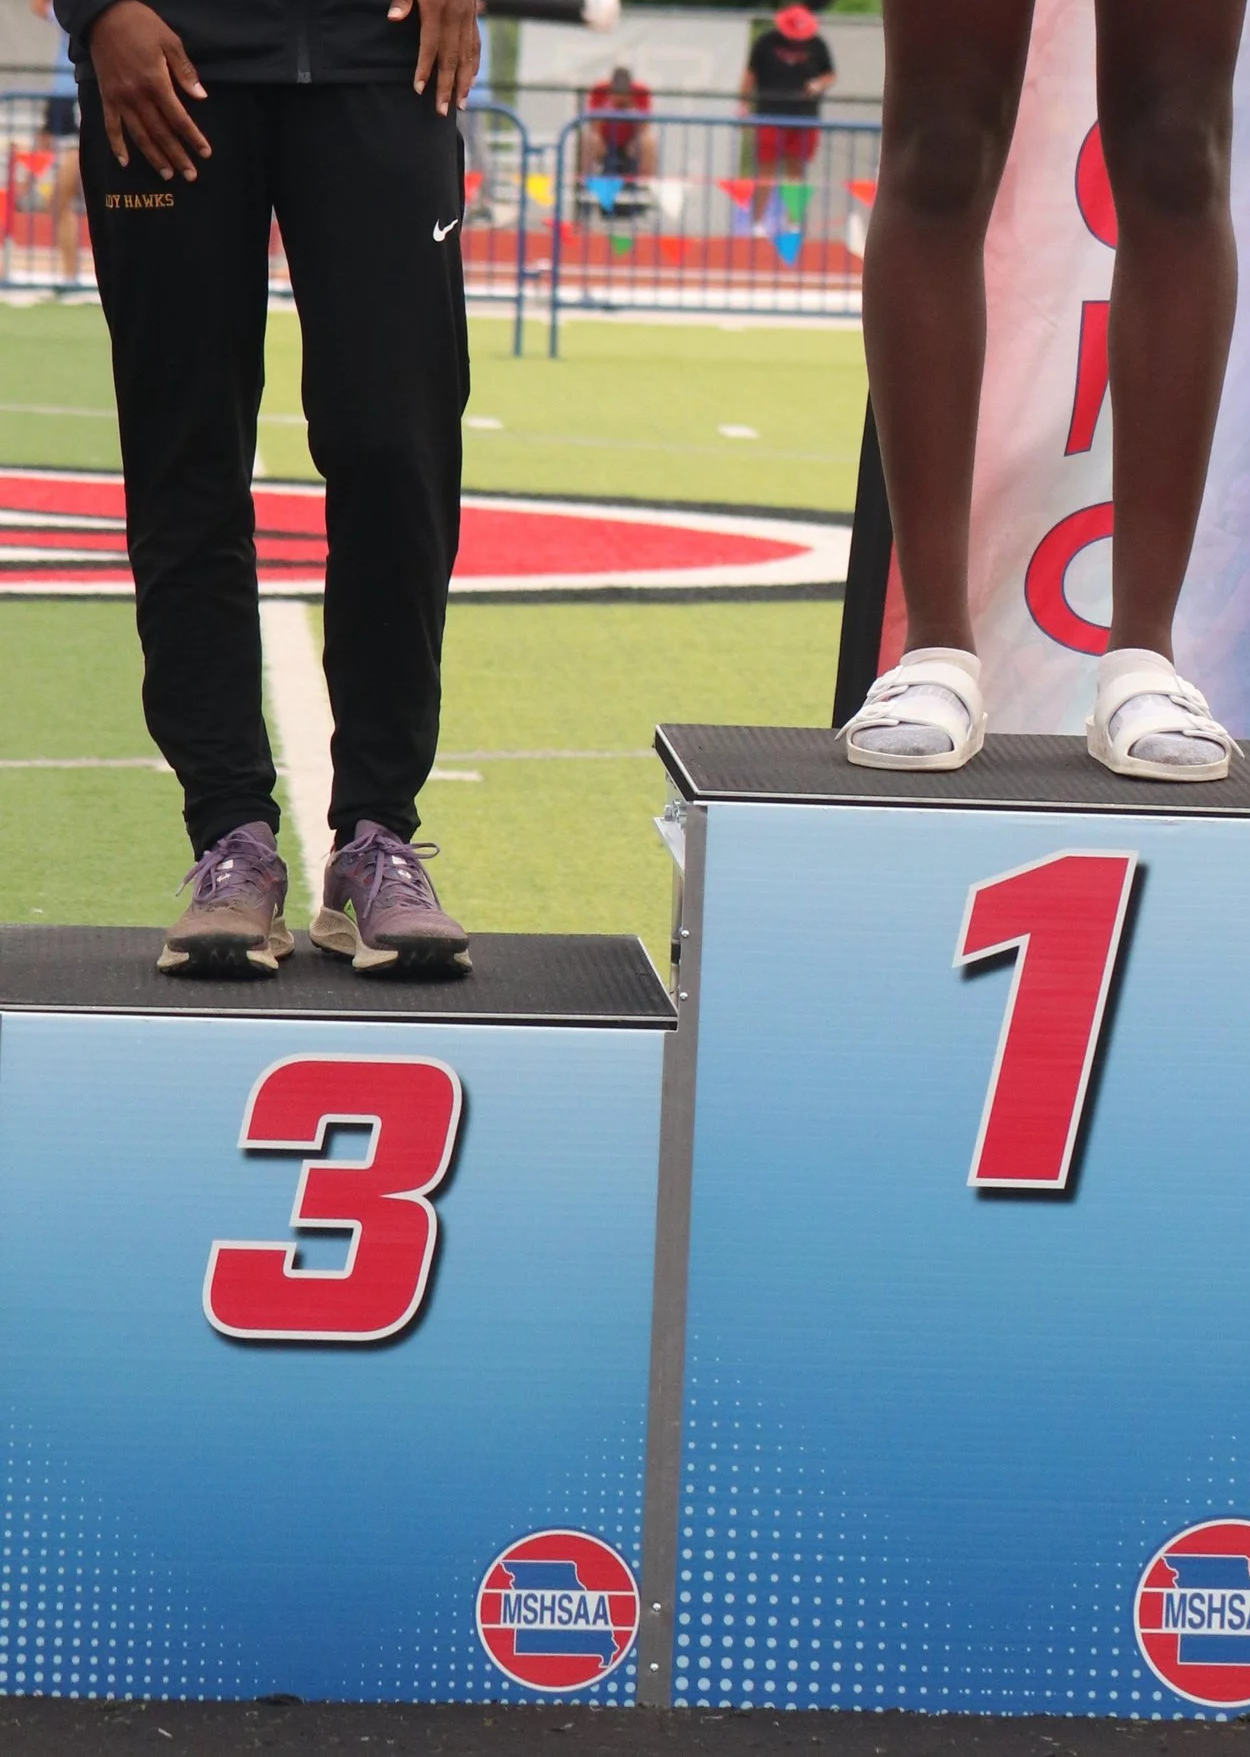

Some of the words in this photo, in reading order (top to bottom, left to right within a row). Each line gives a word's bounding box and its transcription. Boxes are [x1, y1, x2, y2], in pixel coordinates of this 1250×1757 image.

[123, 193, 175, 209] HAWKS
[951, 847, 1140, 1190] 1
[202, 1052, 465, 1342] 3
[500, 1592, 611, 1628] MSHSAA
